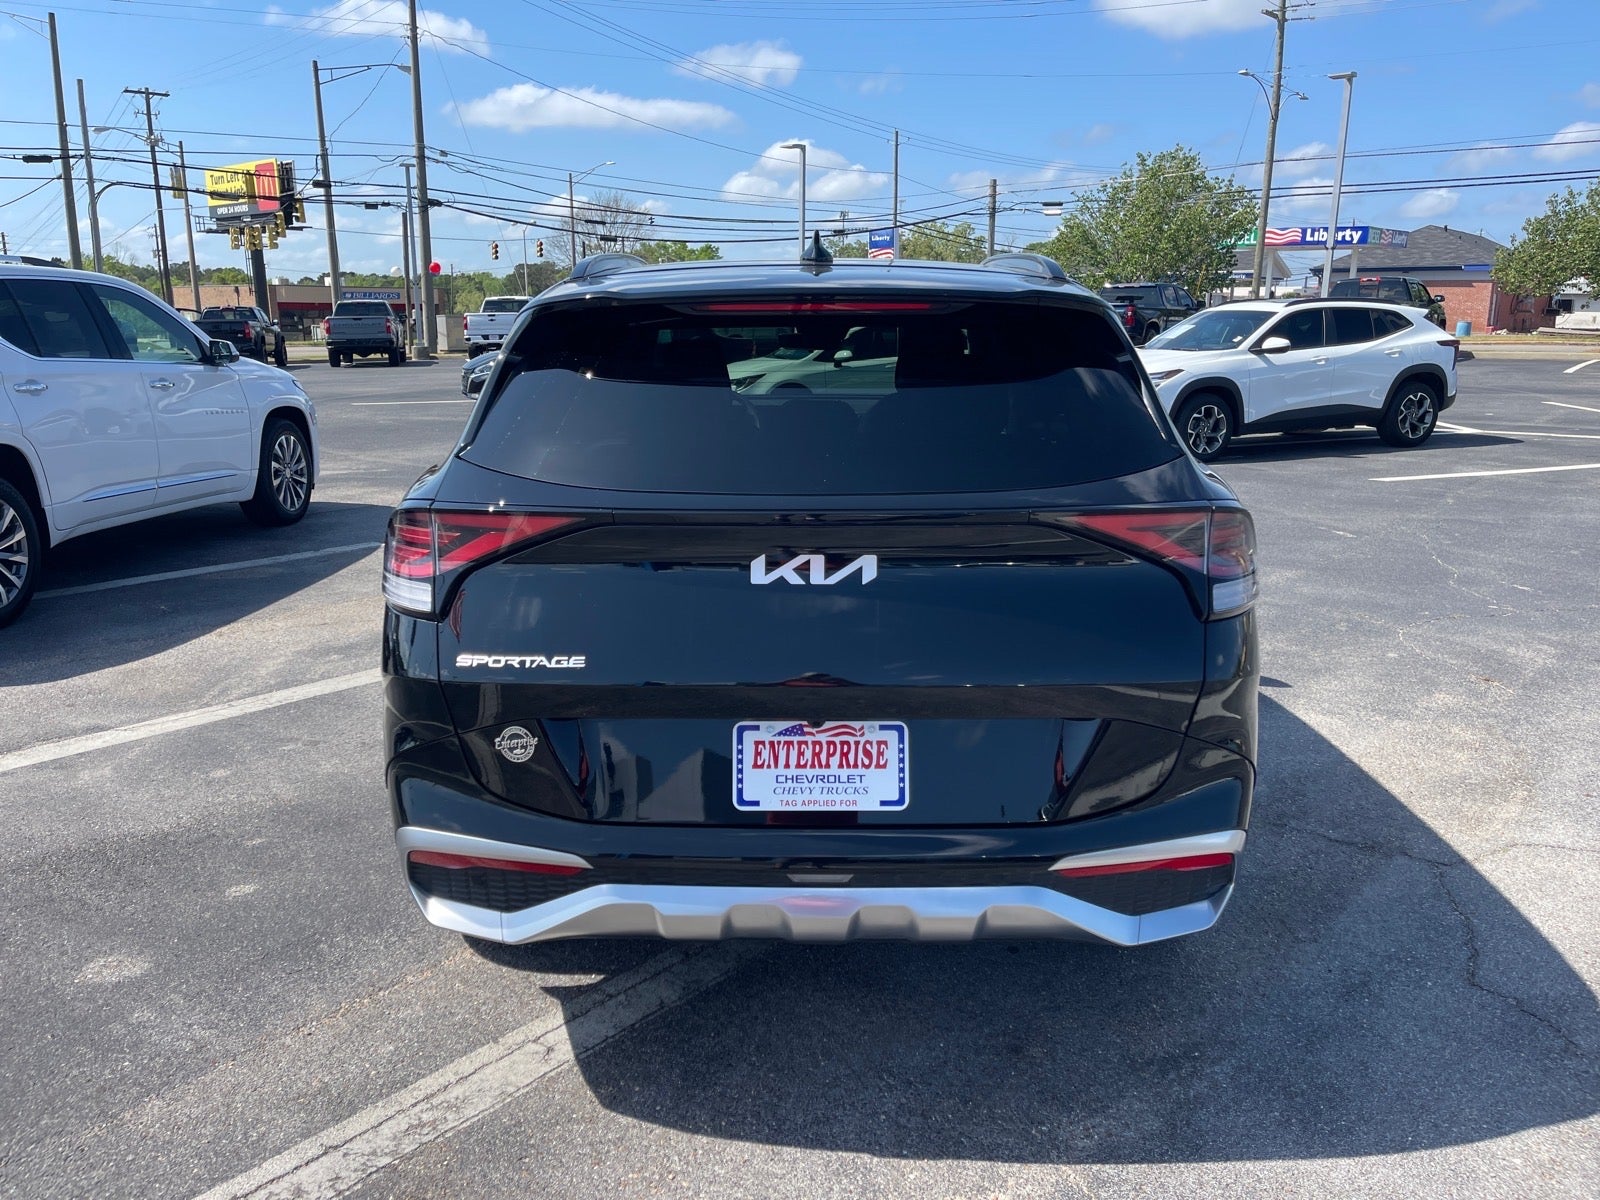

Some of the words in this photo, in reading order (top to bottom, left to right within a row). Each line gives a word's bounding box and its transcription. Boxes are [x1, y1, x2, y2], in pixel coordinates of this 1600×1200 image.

[210, 174, 225, 186] Turn
[226, 171, 240, 184] Left
[216, 207, 228, 215] OPEN
[234, 204, 248, 213] HOURS
[750, 554, 877, 585] KIA
[455, 654, 586, 669] SPORTAGE
[494, 736, 539, 750] Enterprise
[751, 740, 889, 770] ENTERPRISE
[775, 774, 866, 784] CHEVROLET
[773, 786, 815, 795] CHEVY
[819, 786, 869, 795] TRUCKS
[780, 799, 798, 807] TAG
[801, 799, 837, 807] APPLIED
[840, 799, 858, 807] FOR
